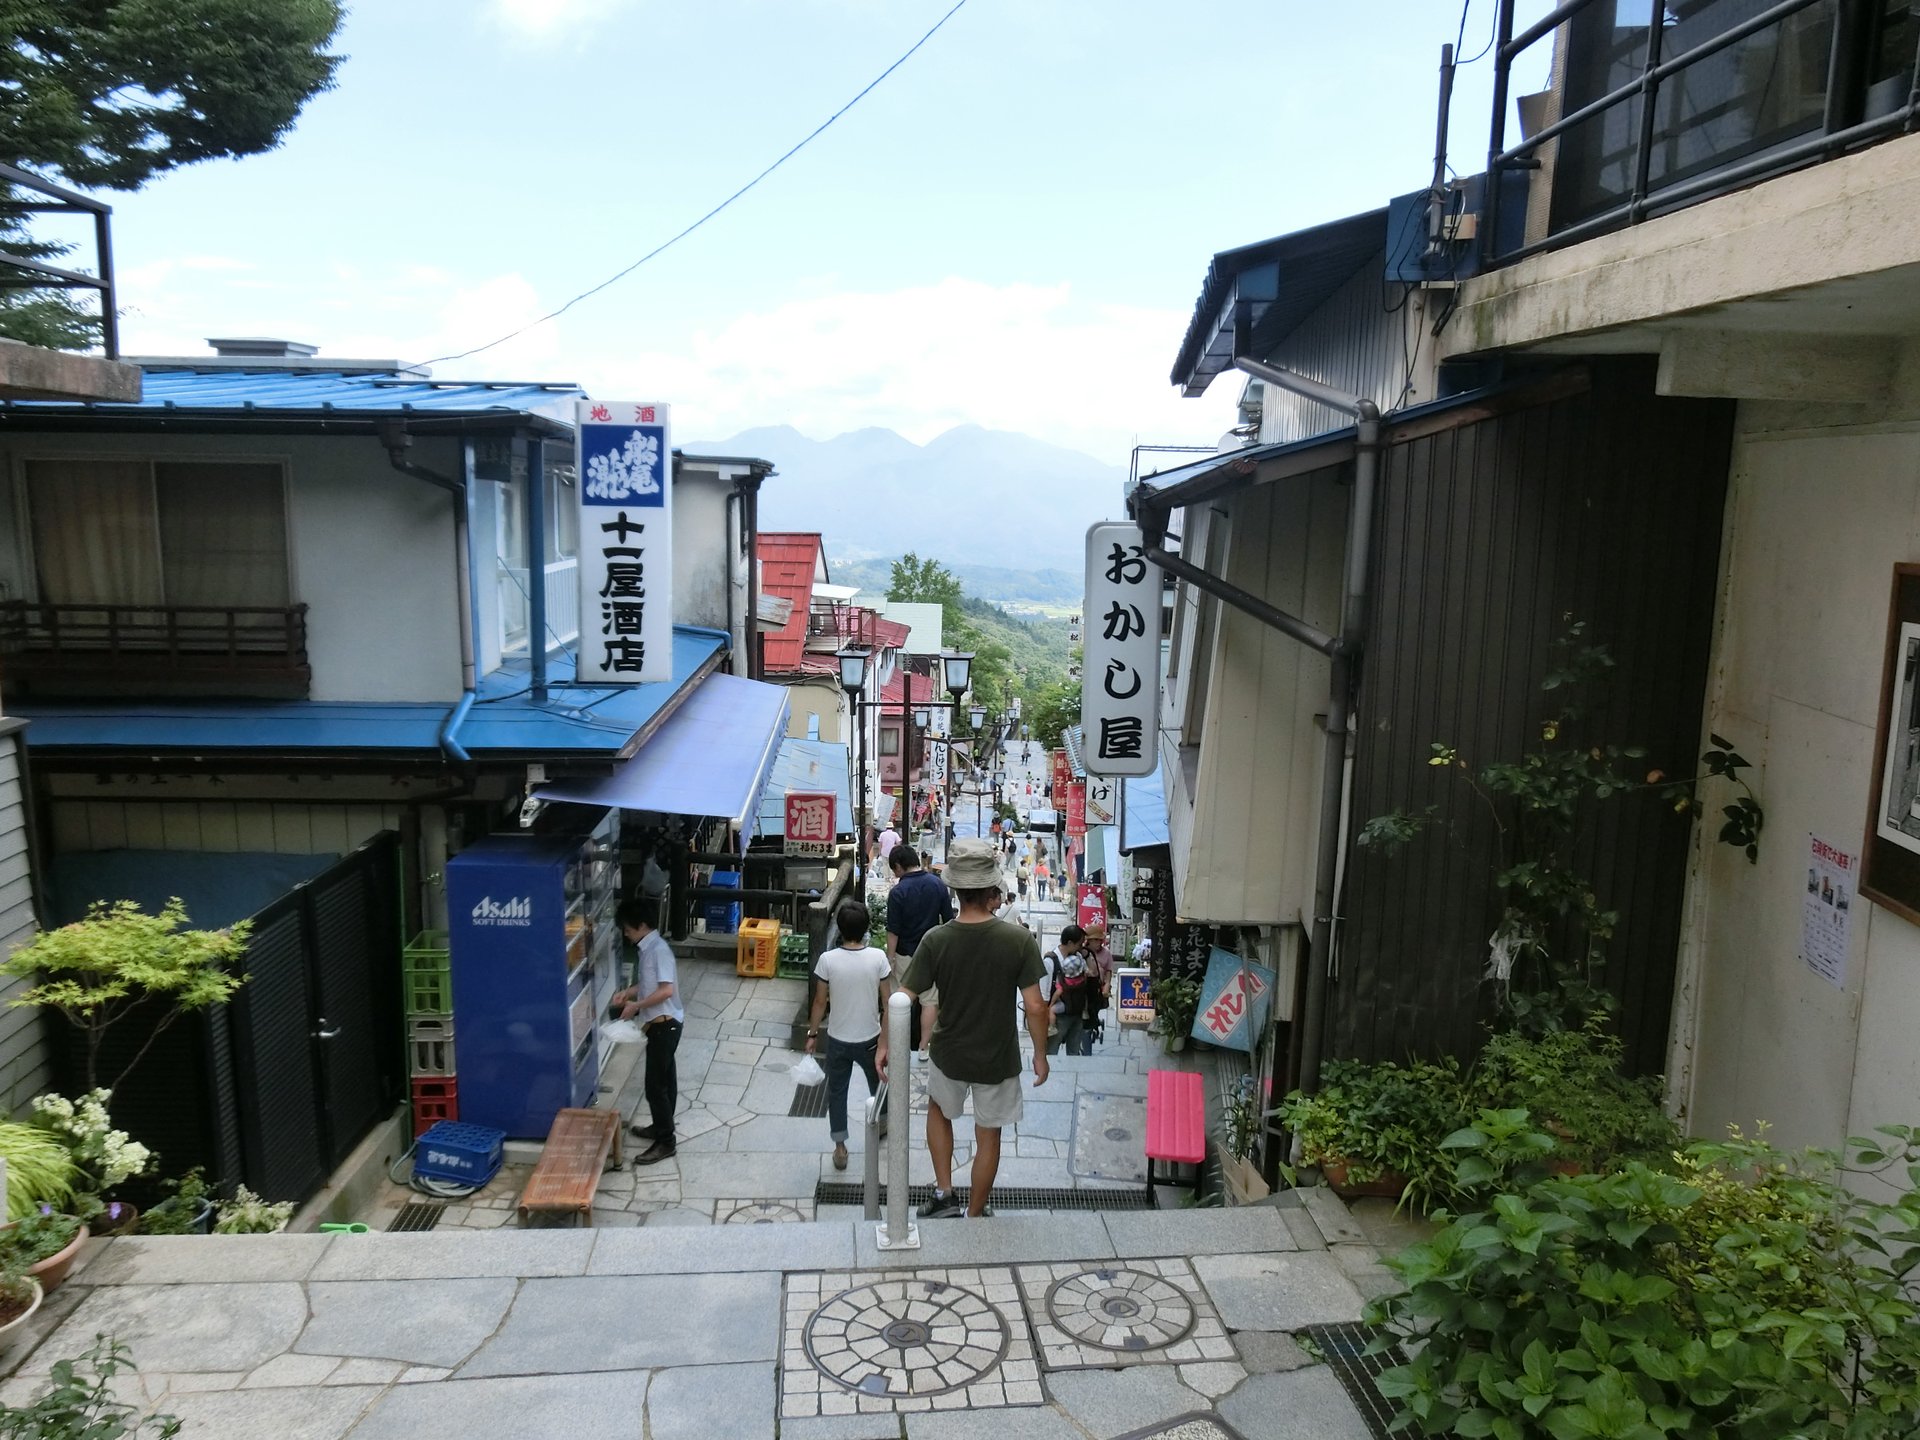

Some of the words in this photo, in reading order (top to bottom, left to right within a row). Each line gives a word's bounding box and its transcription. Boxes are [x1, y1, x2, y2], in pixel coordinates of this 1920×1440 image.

[590, 405, 655, 422] 地酒
[599, 511, 645, 672] 十一屋酒店
[1098, 542, 1147, 759] おかし屋
[790, 798, 830, 839] 酒
[800, 842, 833, 854] 福だるま
[472, 896, 531, 918] Asahi
[1134, 896, 1153, 905] すみ
[757, 939, 766, 969] KIRIN
[1122, 998, 1154, 1007] COFFEE
